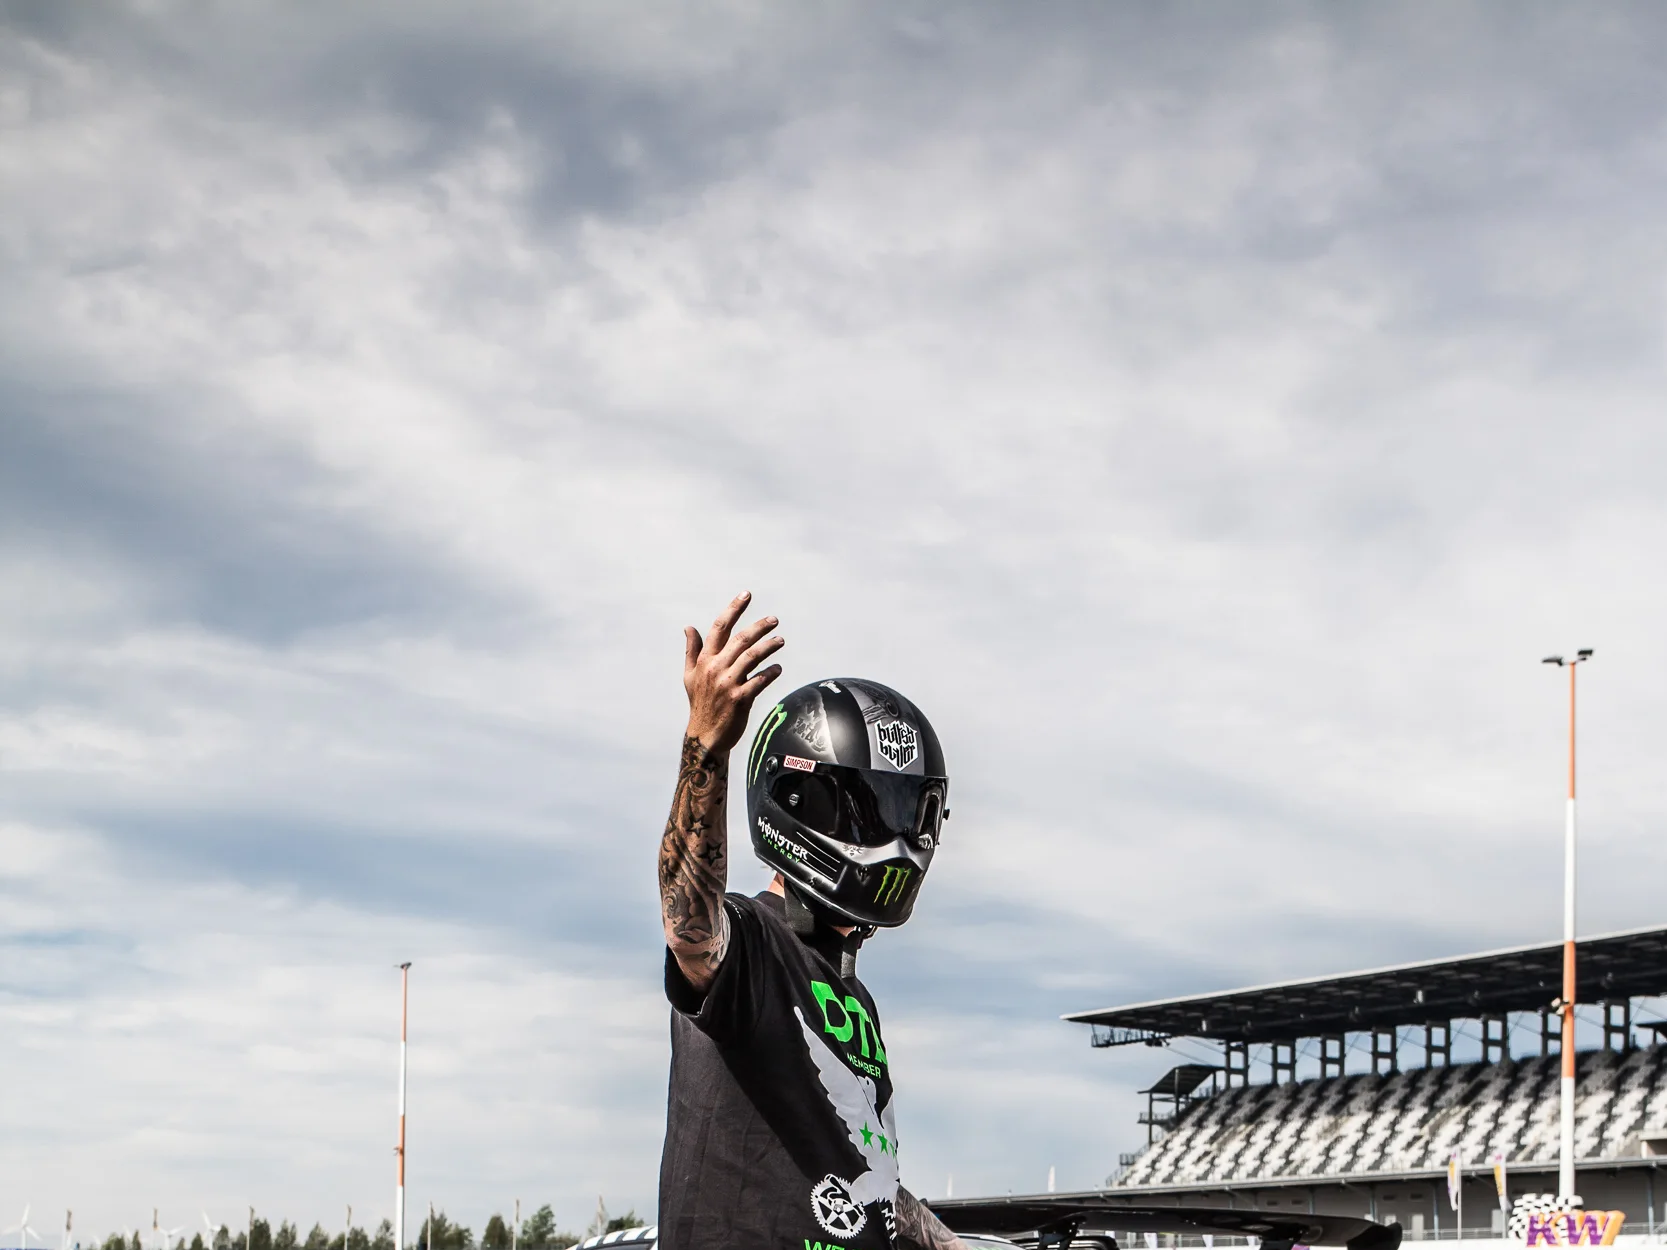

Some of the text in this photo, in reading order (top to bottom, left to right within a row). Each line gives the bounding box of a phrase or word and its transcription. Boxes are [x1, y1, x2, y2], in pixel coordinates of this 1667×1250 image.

[785, 757, 813, 770] SIMPSON
[757, 816, 808, 861] MONSTER
[762, 833, 800, 863] ENERGY
[846, 1052, 881, 1079] MEMBER
[1526, 1211, 1620, 1247] KW
